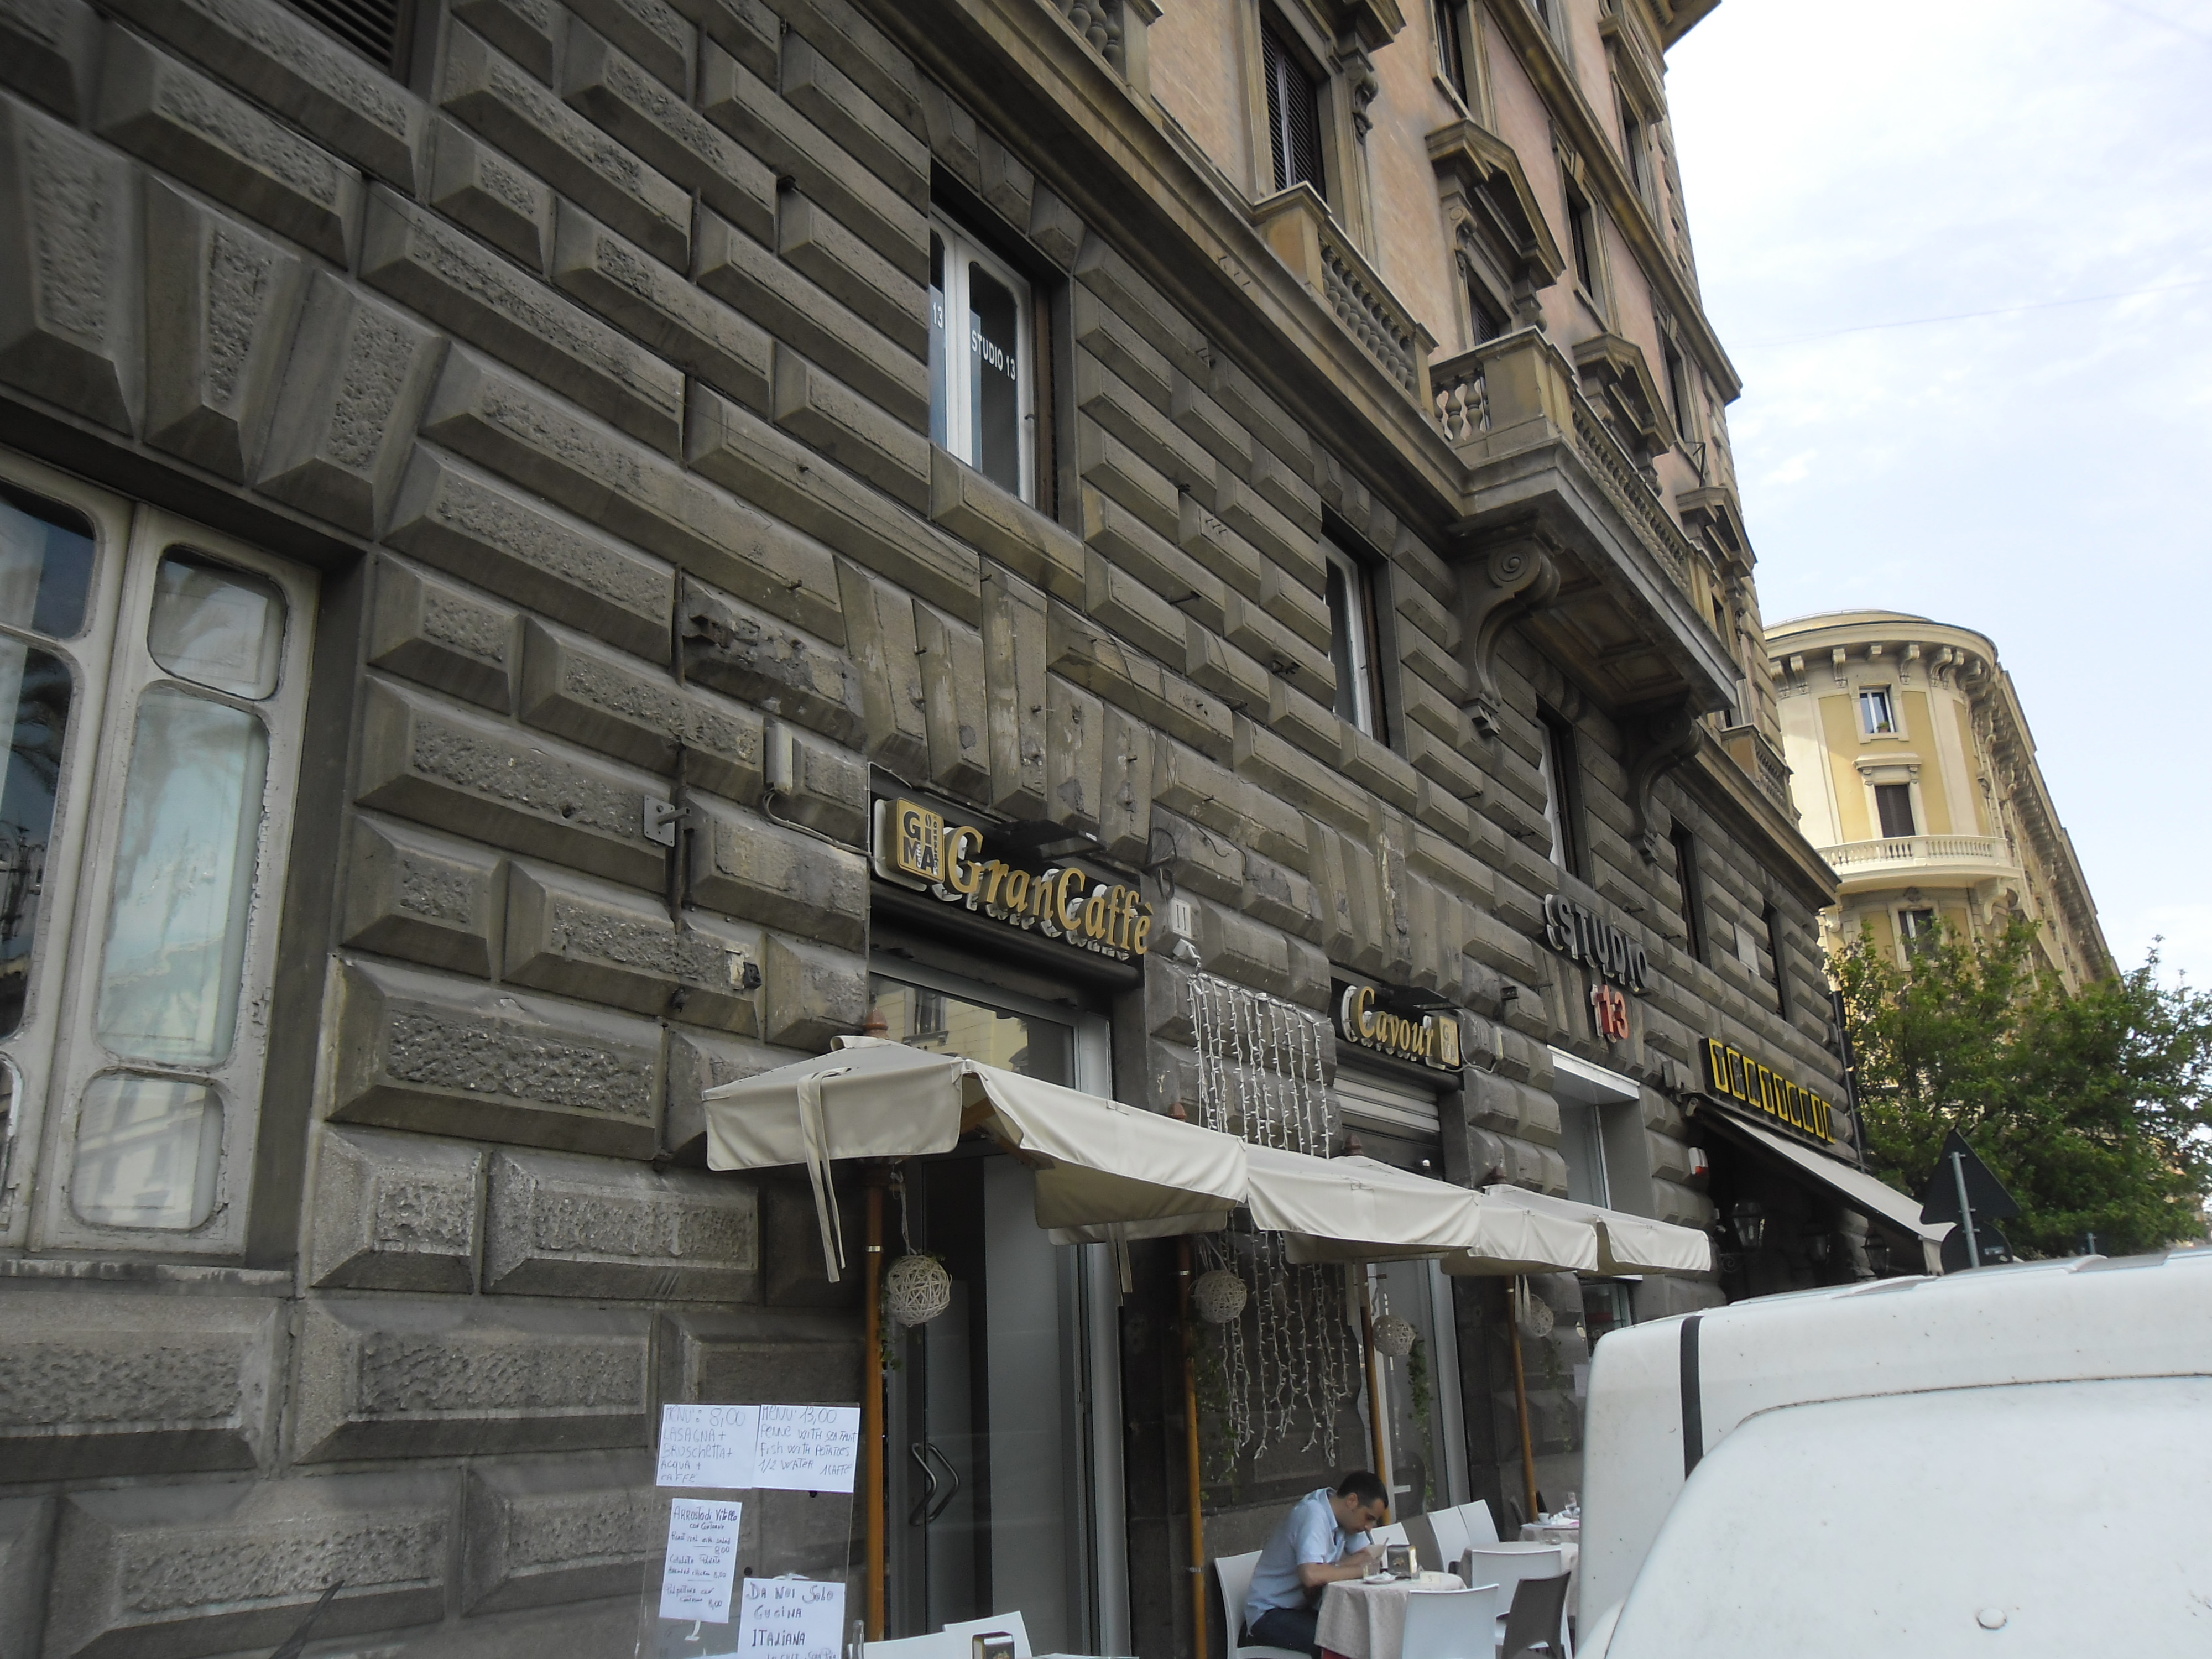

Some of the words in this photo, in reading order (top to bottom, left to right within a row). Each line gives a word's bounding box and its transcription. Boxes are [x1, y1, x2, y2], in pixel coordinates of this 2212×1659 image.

[972, 330, 1004, 371] STUDIO
[1006, 355, 1016, 380] 13
[1550, 894, 1649, 989] STUDIO
[1358, 985, 1434, 1057] Cavour
[1594, 984, 1630, 1040] 13
